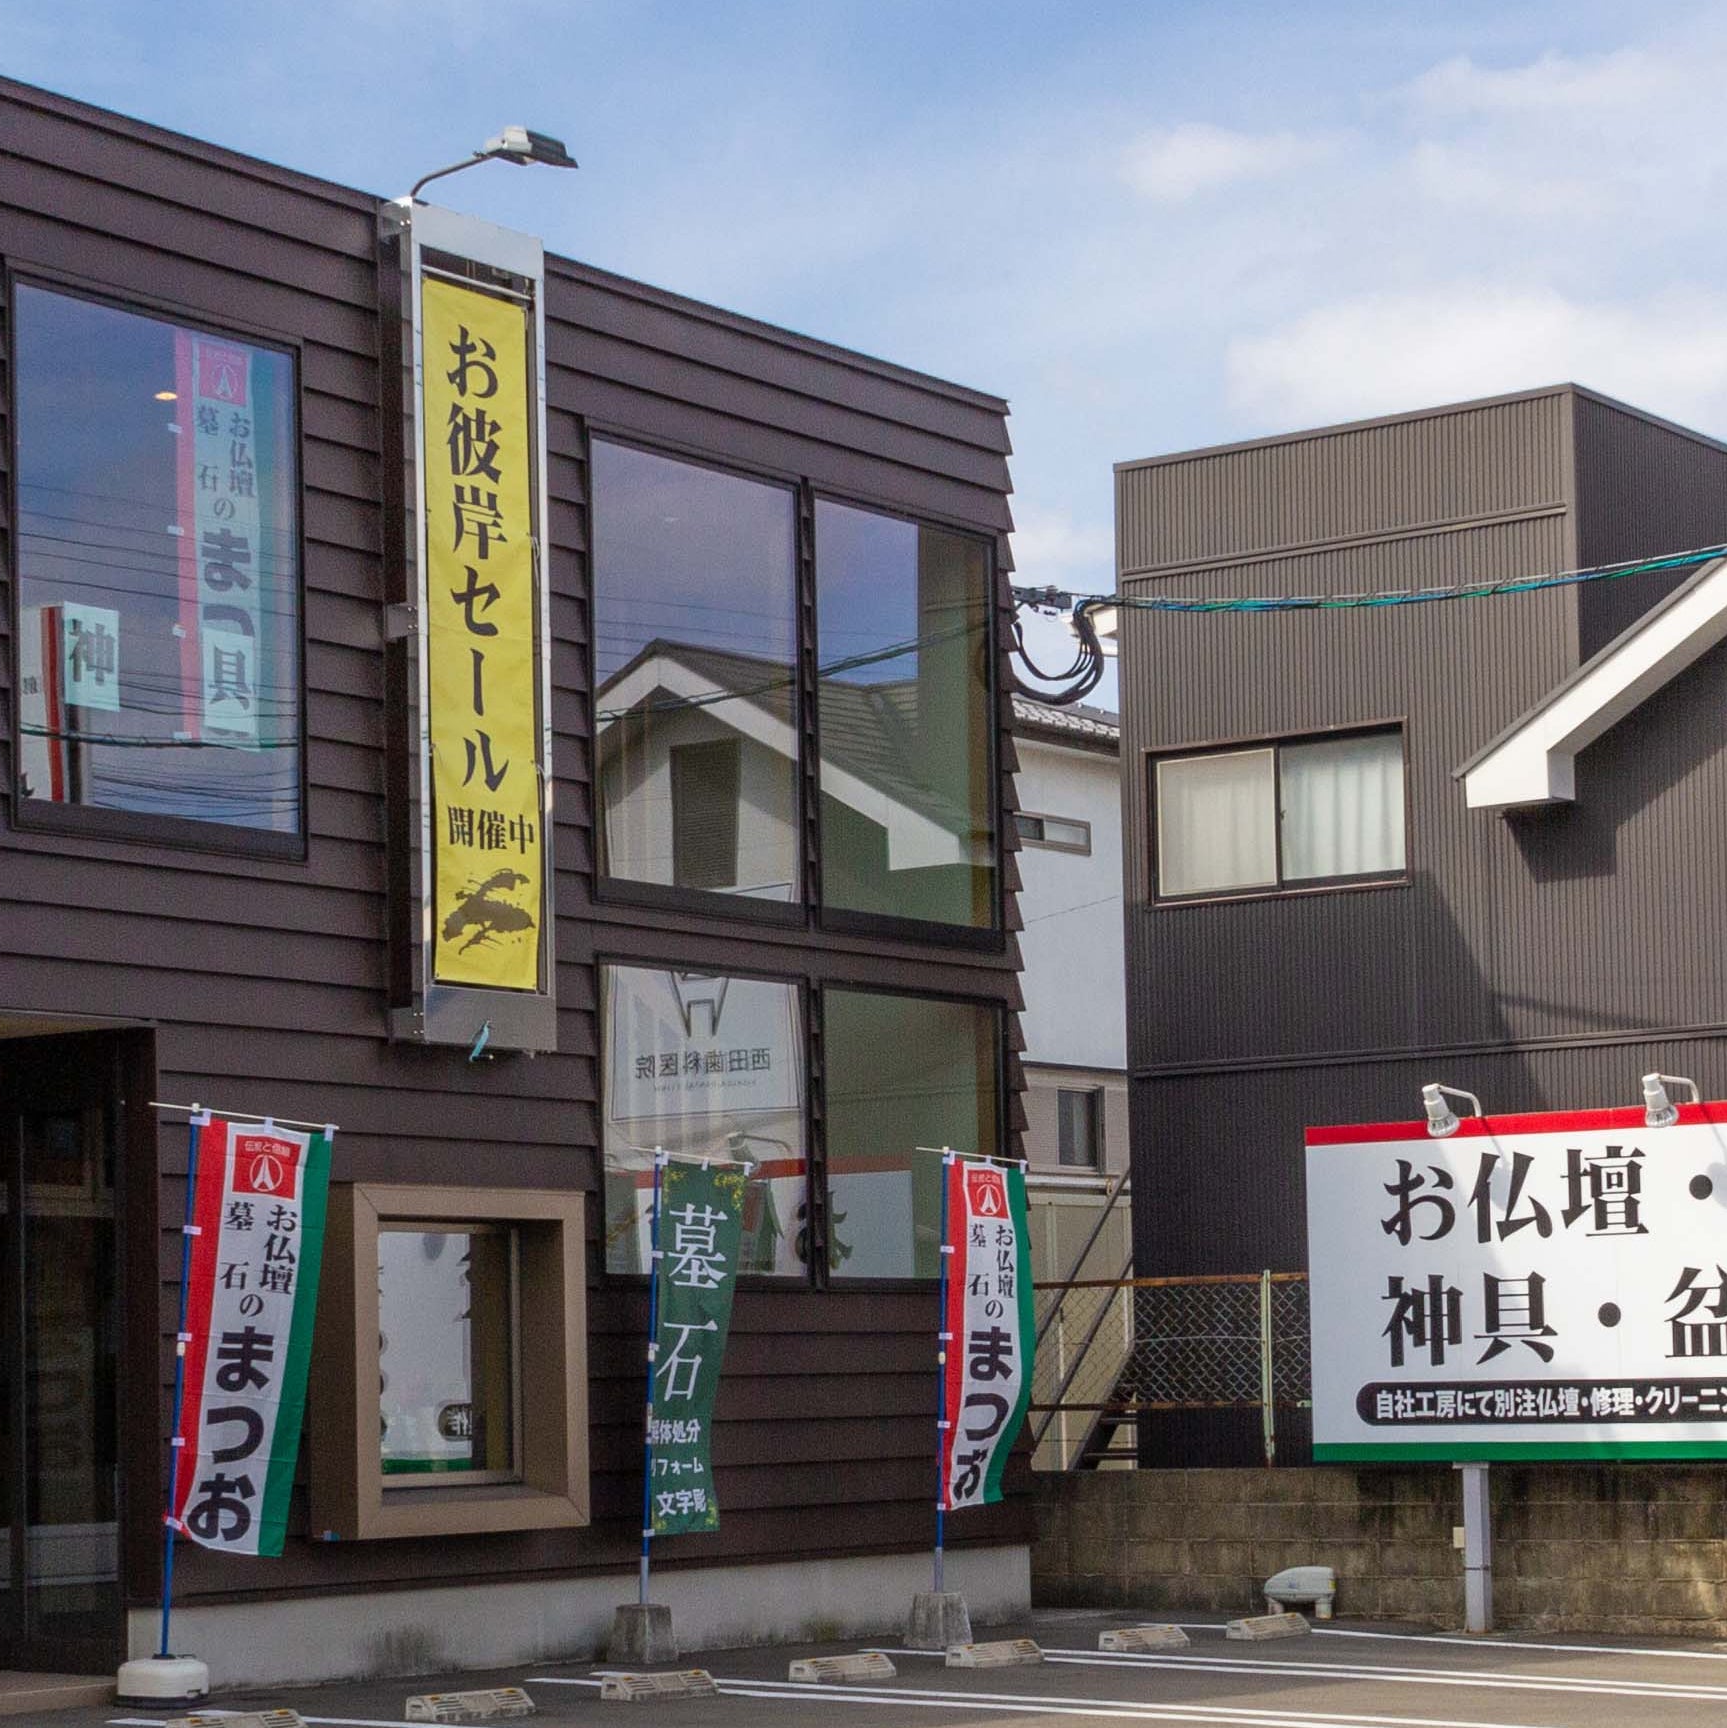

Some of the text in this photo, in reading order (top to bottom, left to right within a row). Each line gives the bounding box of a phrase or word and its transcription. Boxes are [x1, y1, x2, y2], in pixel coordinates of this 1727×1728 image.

[447, 324, 509, 791] お彼岸セール
[448, 804, 535, 855] 開催中
[258, 1204, 298, 1295] お仏壇
[995, 1225, 1014, 1298] お仏壇
[239, 1293, 265, 1317] の
[656, 1203, 728, 1403] 墓石
[186, 1325, 274, 1543] まつお
